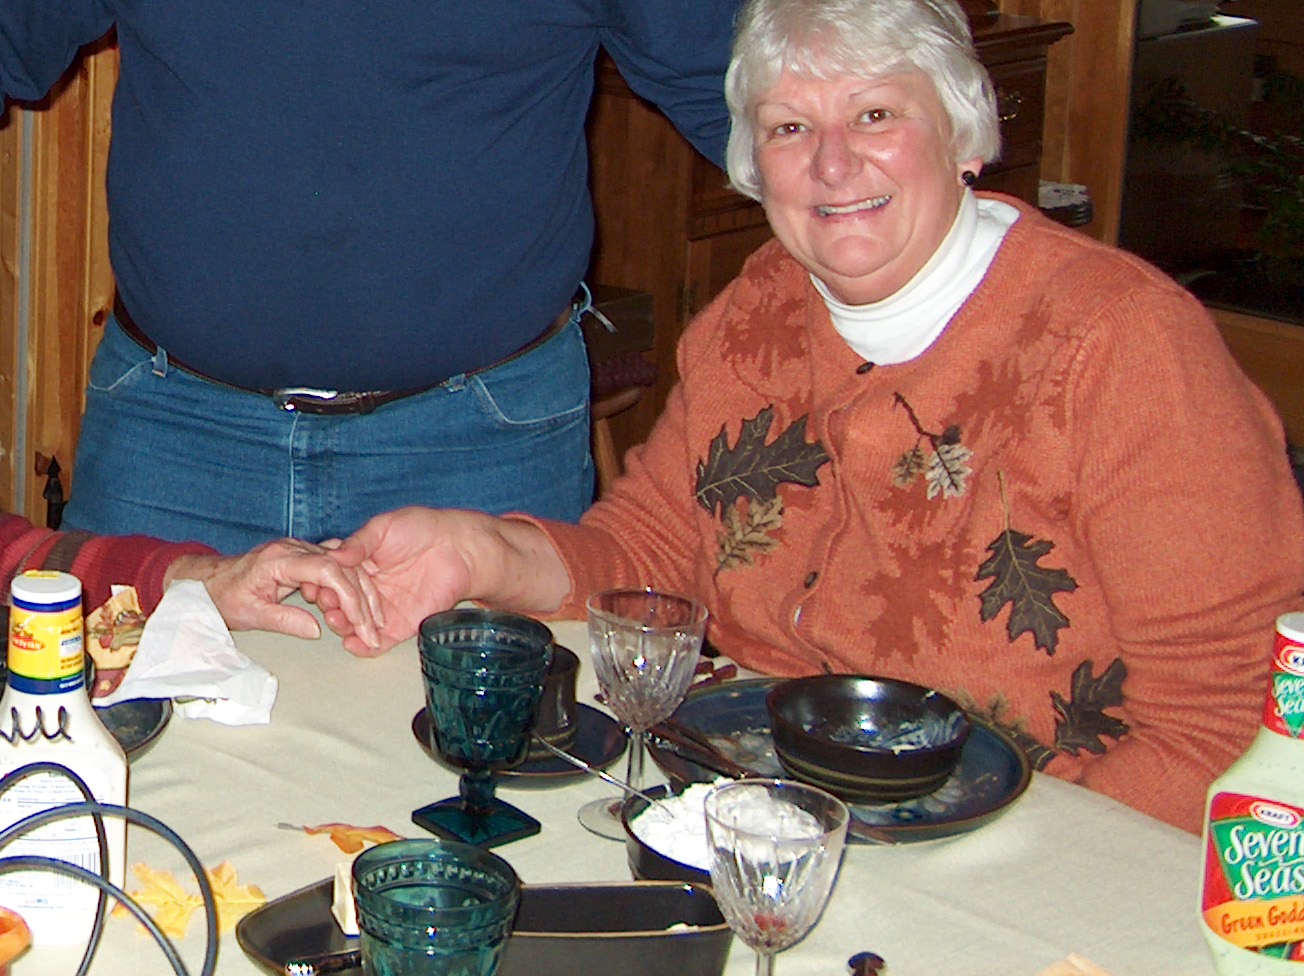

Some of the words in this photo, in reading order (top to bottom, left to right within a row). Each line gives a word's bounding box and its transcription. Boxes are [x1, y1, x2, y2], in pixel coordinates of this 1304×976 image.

[1272, 677, 1304, 699] Seve
[1274, 698, 1304, 718] Sea
[1224, 825, 1304, 865] Seven
[1221, 913, 1265, 934] Green
